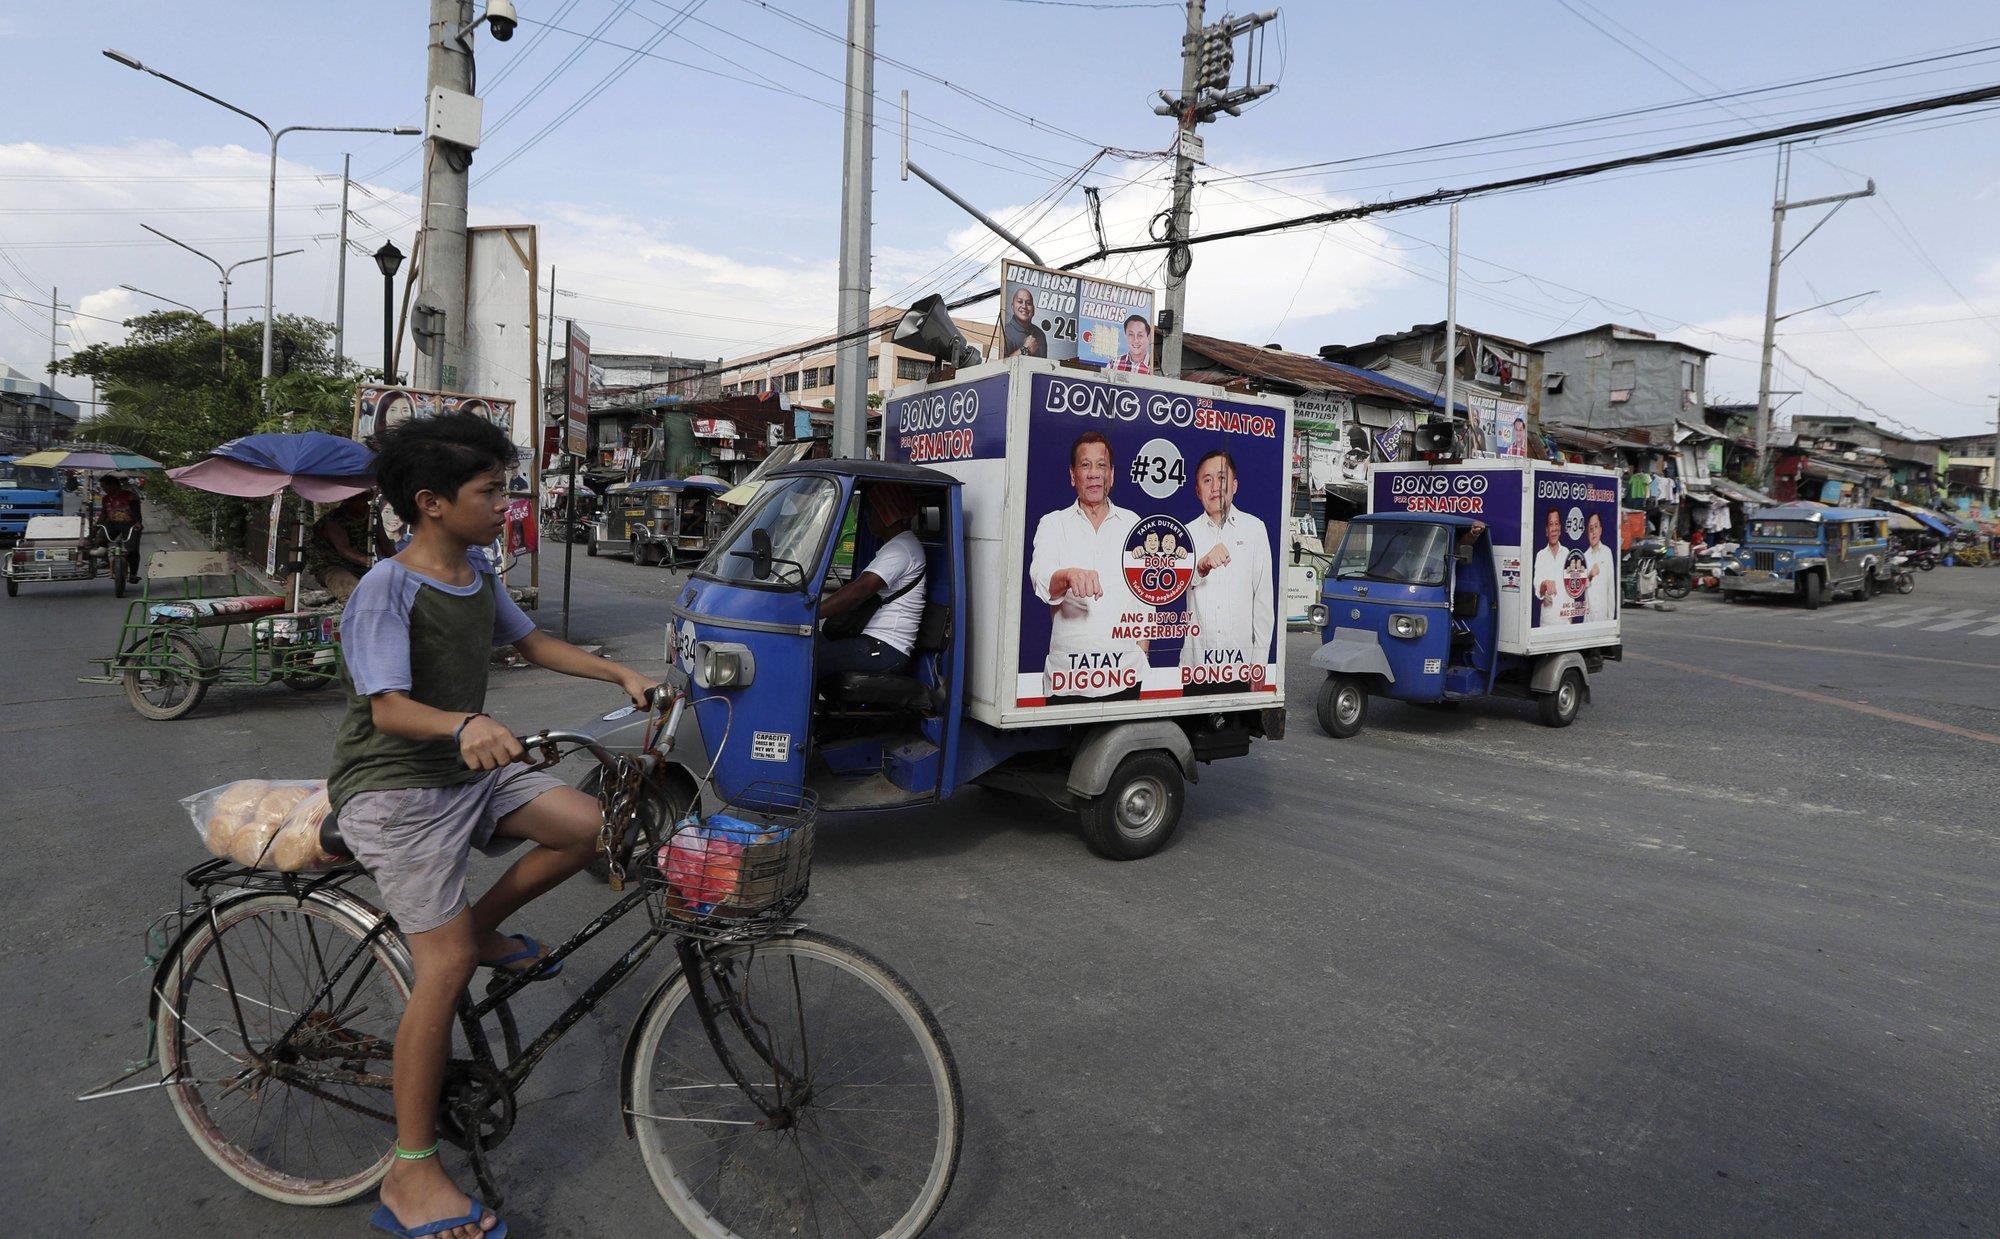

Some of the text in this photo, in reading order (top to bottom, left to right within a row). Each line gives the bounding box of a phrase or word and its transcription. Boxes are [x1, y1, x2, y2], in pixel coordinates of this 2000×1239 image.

[1007, 265, 1078, 294] DELA ROSA
[1037, 291, 1076, 314] BATO
[1082, 279, 1148, 308] TOLENTINO
[1081, 301, 1127, 322] FRANCIS
[1053, 316, 1078, 342] 24
[899, 388, 979, 433] BONG GO
[1046, 380, 1193, 427] BONG GO
[1196, 397, 1213, 409] FOR
[1293, 400, 1340, 413] AKBAYAN
[1194, 408, 1276, 439] SENATOR
[1294, 409, 1337, 420] PARTYLIST
[1487, 422, 1496, 436] 24
[910, 428, 974, 462] SENATOR
[1131, 454, 1186, 486] #34
[1392, 475, 1488, 494] BONG GO
[1538, 480, 1587, 500] BONG GO
[1407, 496, 1483, 513] SENATOR
[1137, 520, 1184, 538] TATAK DUTERTE
[1565, 517, 1585, 532] #34
[1144, 555, 1175, 567] BONG
[1141, 567, 1177, 591] GO
[1120, 611, 1193, 623] ANG BISYO AY
[1111, 624, 1200, 639] MAG SERBISYO
[1068, 652, 1123, 669] TATAY
[1204, 649, 1244, 664] KUYA
[1052, 668, 1137, 691] DIGONG
[1181, 663, 1265, 685] BONG GO
